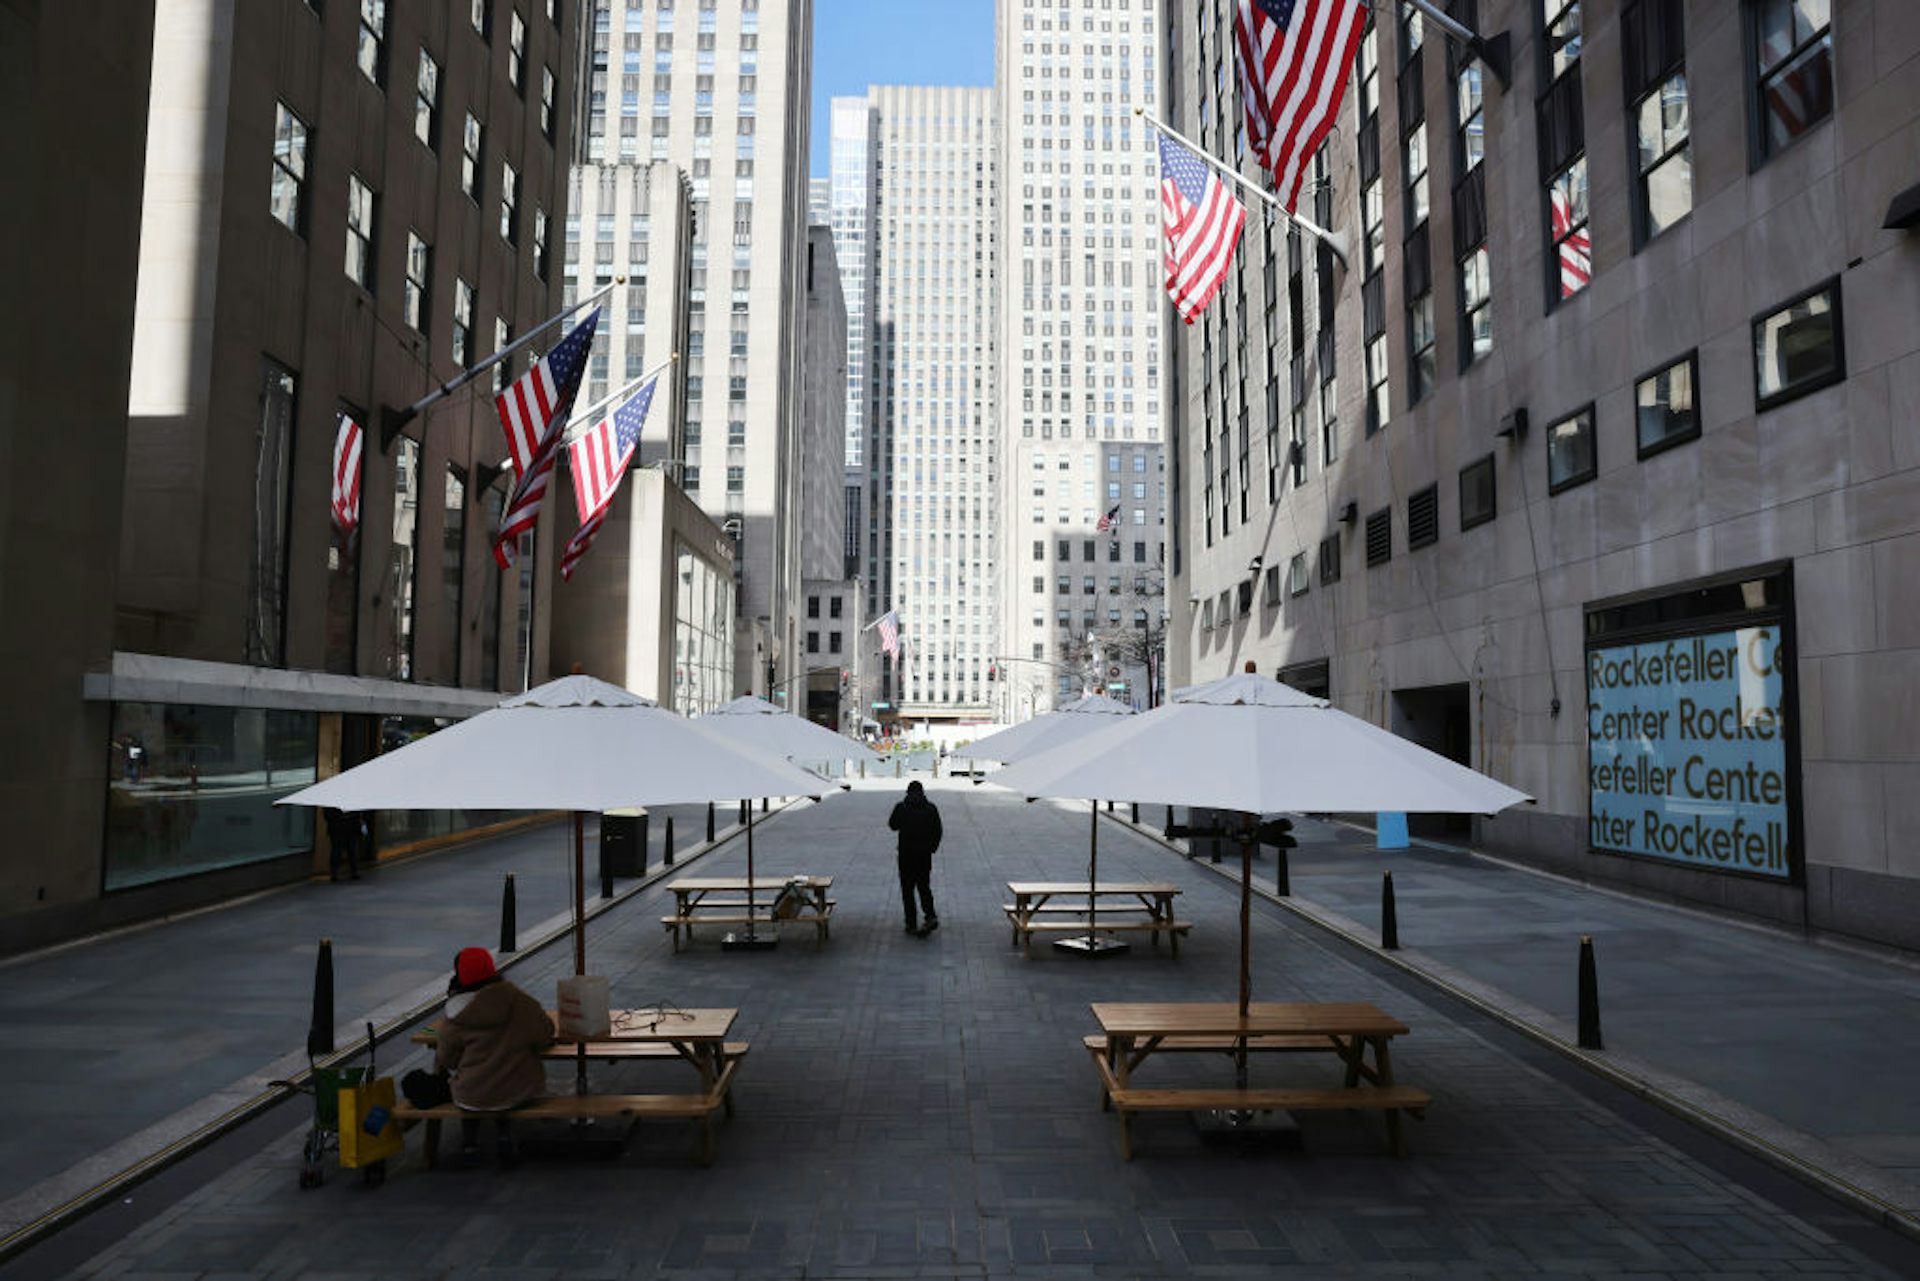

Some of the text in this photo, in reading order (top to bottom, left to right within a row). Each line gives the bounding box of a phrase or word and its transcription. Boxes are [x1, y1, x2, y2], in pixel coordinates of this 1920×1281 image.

[1591, 640, 1738, 690] Rockefeller
[1589, 703, 1669, 740] Center
[1684, 755, 1781, 805] Cente
[1644, 810, 1790, 869] Rockefell
